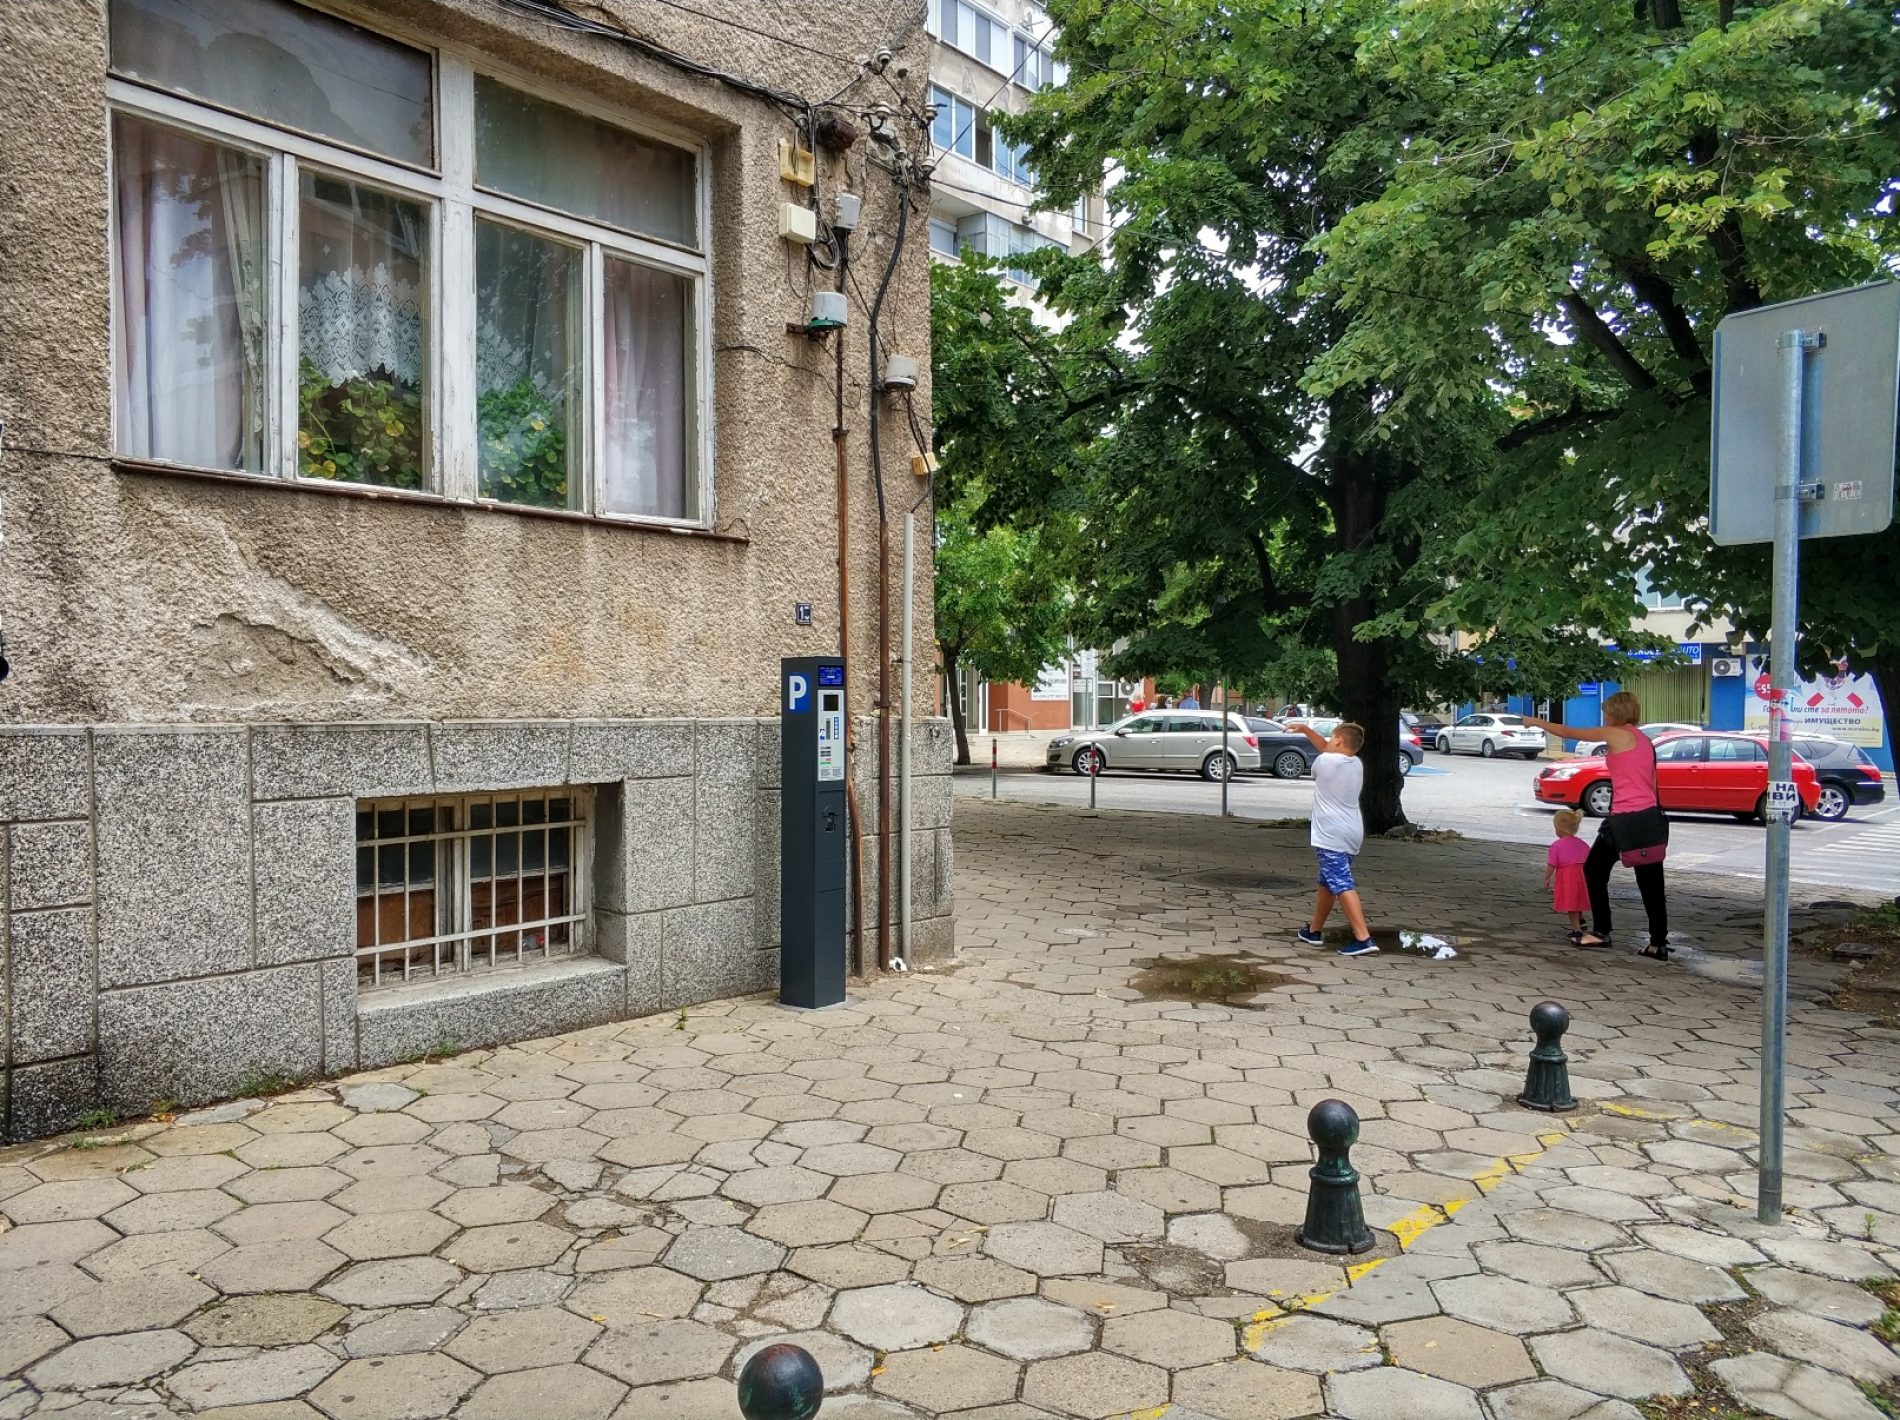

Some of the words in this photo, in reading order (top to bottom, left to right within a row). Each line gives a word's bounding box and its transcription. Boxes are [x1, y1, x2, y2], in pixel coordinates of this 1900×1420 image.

[788, 675, 807, 710] P
[1804, 717, 1861, 725] ИМУЩЕСТВО
[1776, 783, 1795, 792] НА
